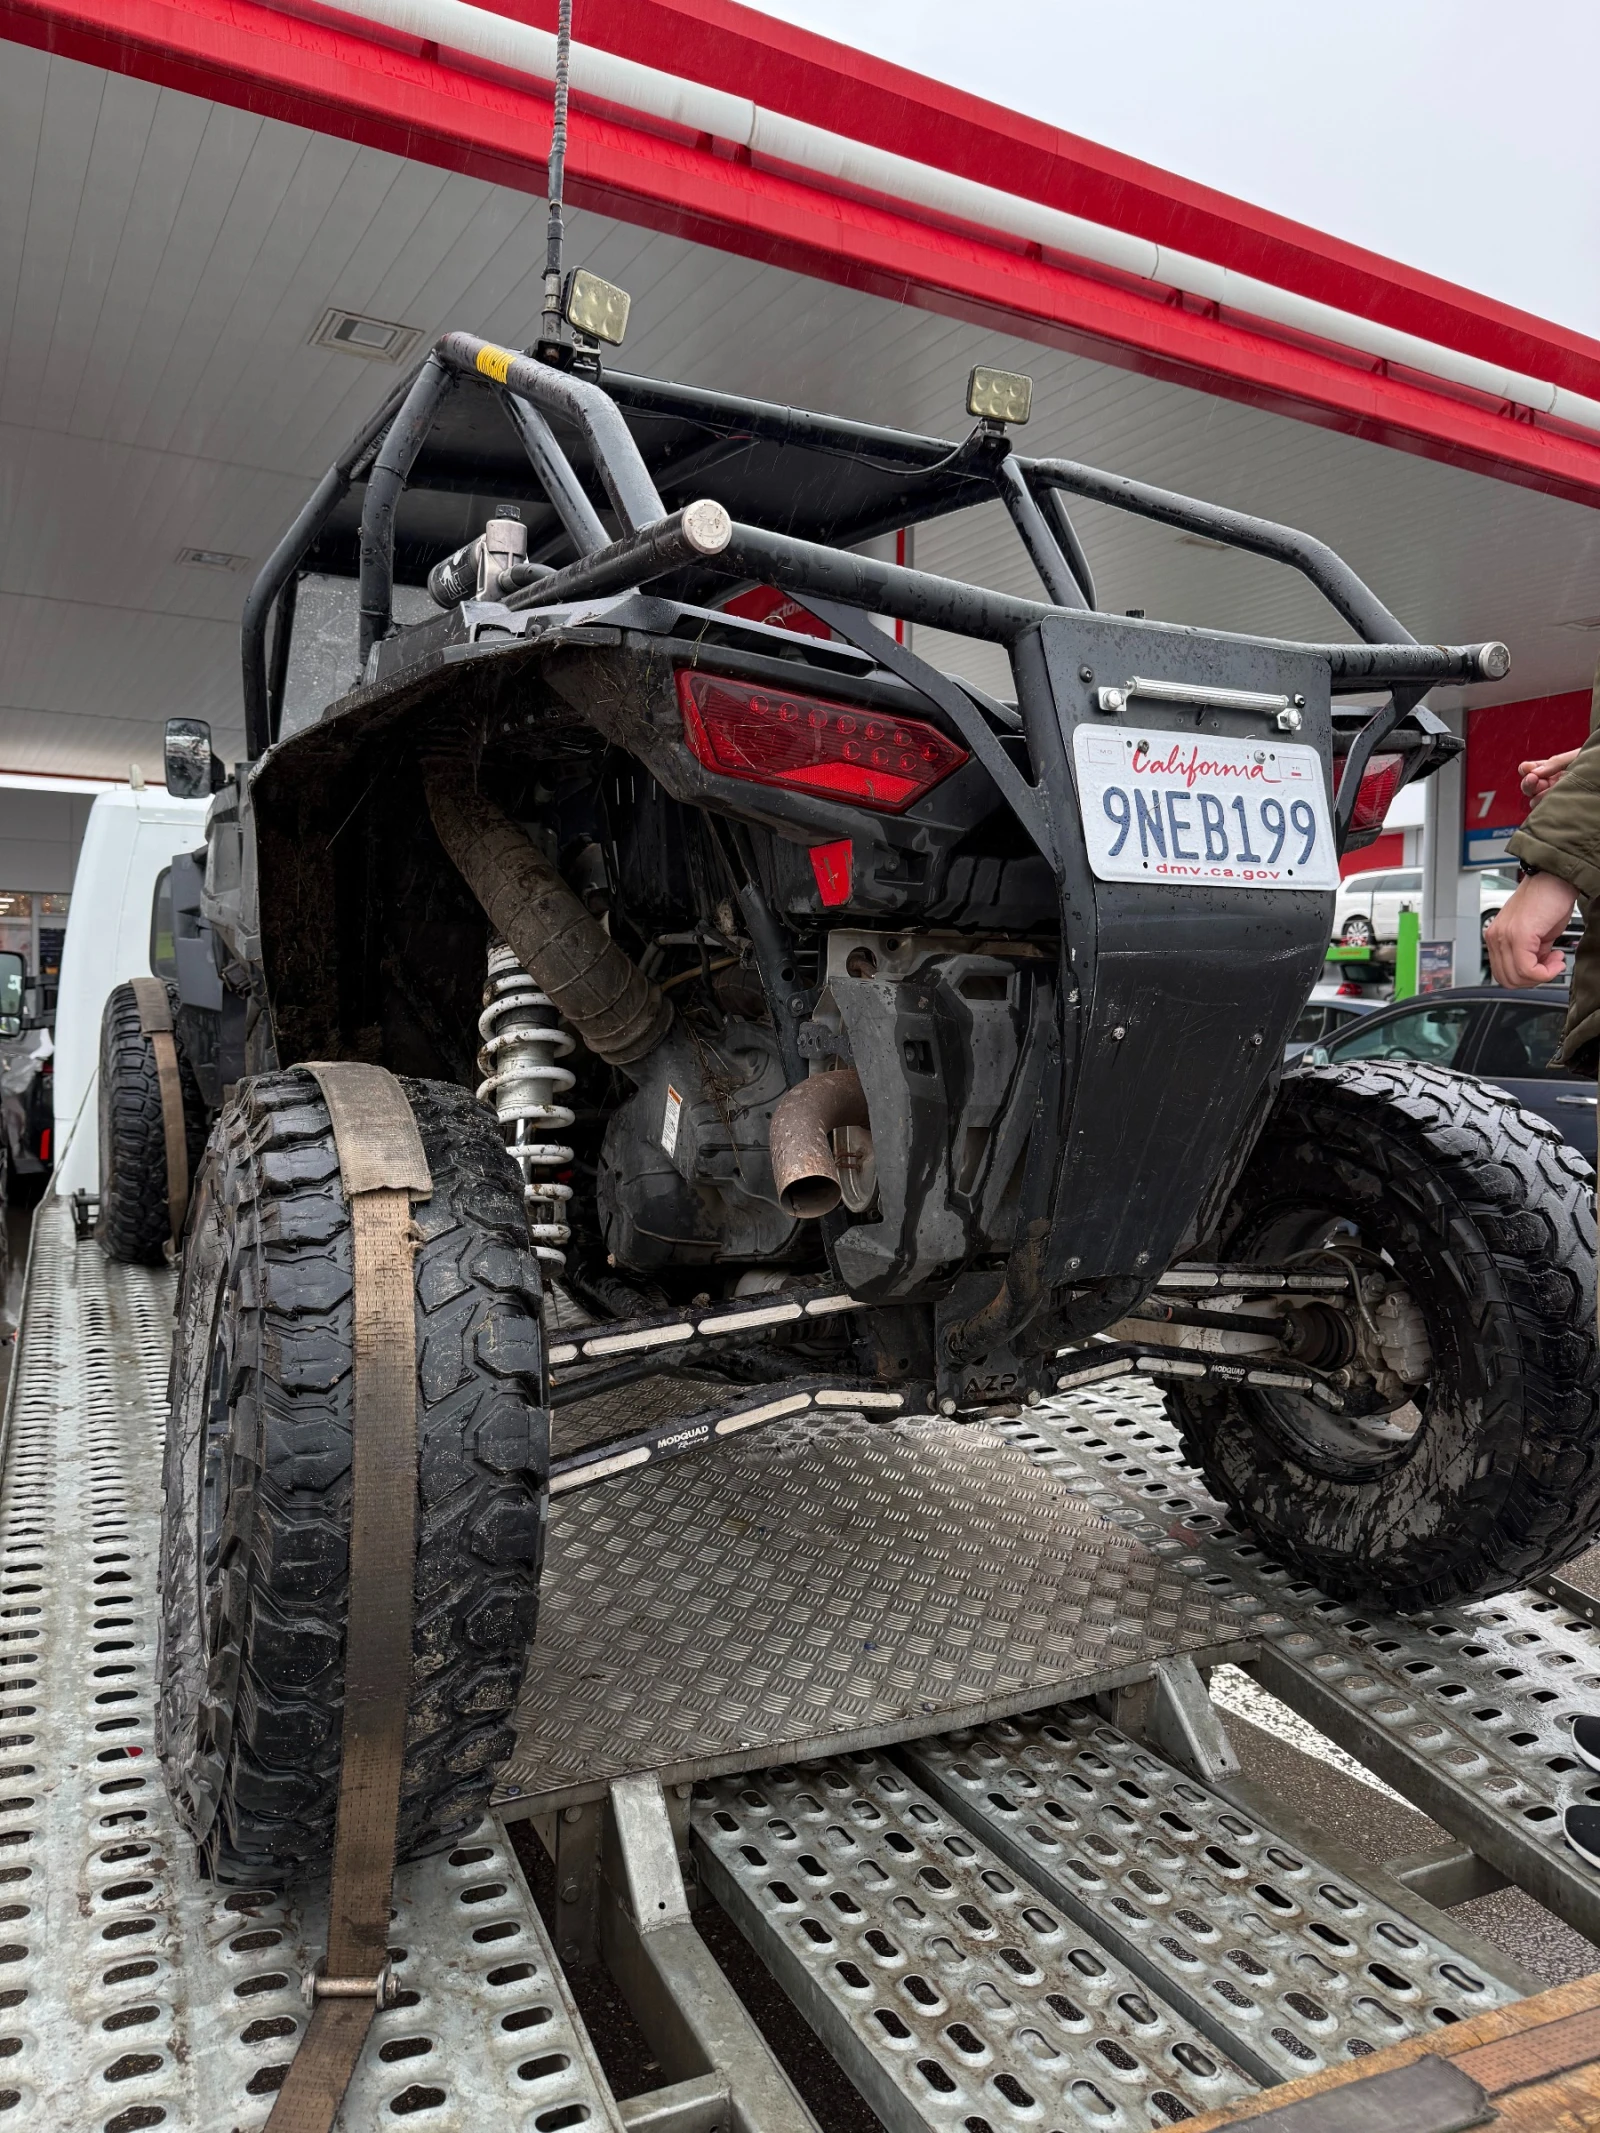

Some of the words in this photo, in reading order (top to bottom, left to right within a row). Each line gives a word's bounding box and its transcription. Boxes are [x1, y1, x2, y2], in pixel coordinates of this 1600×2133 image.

[1132, 744, 1282, 788] California
[1477, 790, 1497, 818] 7
[1102, 786, 1316, 865] 9NEB199
[1156, 863, 1281, 881] dmv.ca.gov
[1210, 1364, 1246, 1376] MODQUAD
[657, 1425, 709, 1449] MODQUAD
[677, 1436, 709, 1449] Racing
